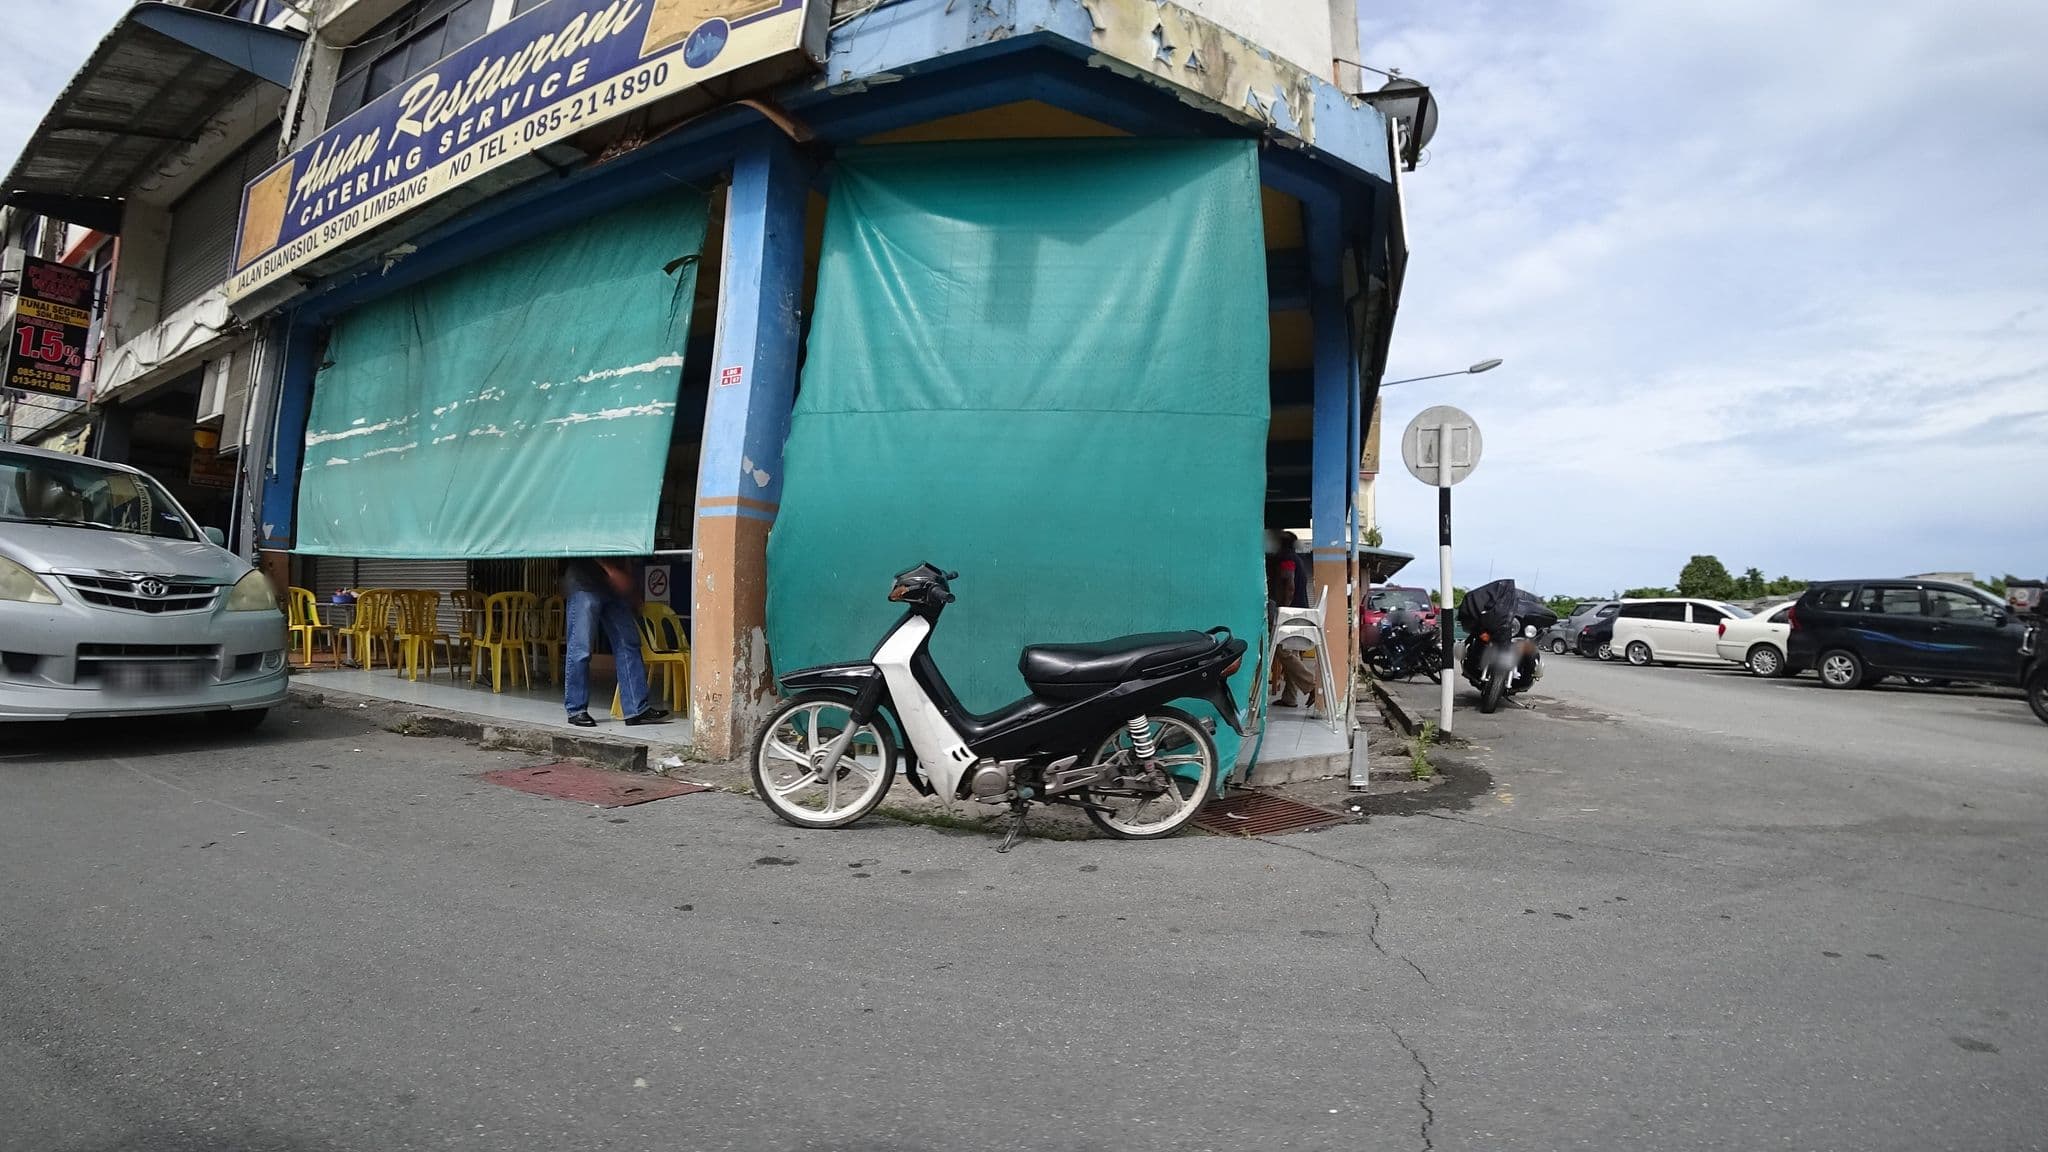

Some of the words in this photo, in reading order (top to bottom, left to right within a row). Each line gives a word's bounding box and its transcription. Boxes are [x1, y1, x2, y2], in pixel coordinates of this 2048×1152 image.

[237, 264, 262, 293] JALAN
[263, 232, 319, 276] BUANGSIOL
[323, 212, 359, 243] 98700
[363, 176, 428, 223] LIMBANG
[449, 153, 471, 180] NO
[523, 62, 669, 143] 085-214890
[288, 126, 381, 215] Adnan
[387, 0, 643, 151] Restaurant
[300, 147, 422, 227] CATERING
[438, 58, 590, 154] SERVICE
[20, 297, 50, 312] TUNAI
[51, 303, 89, 321] SEGERA
